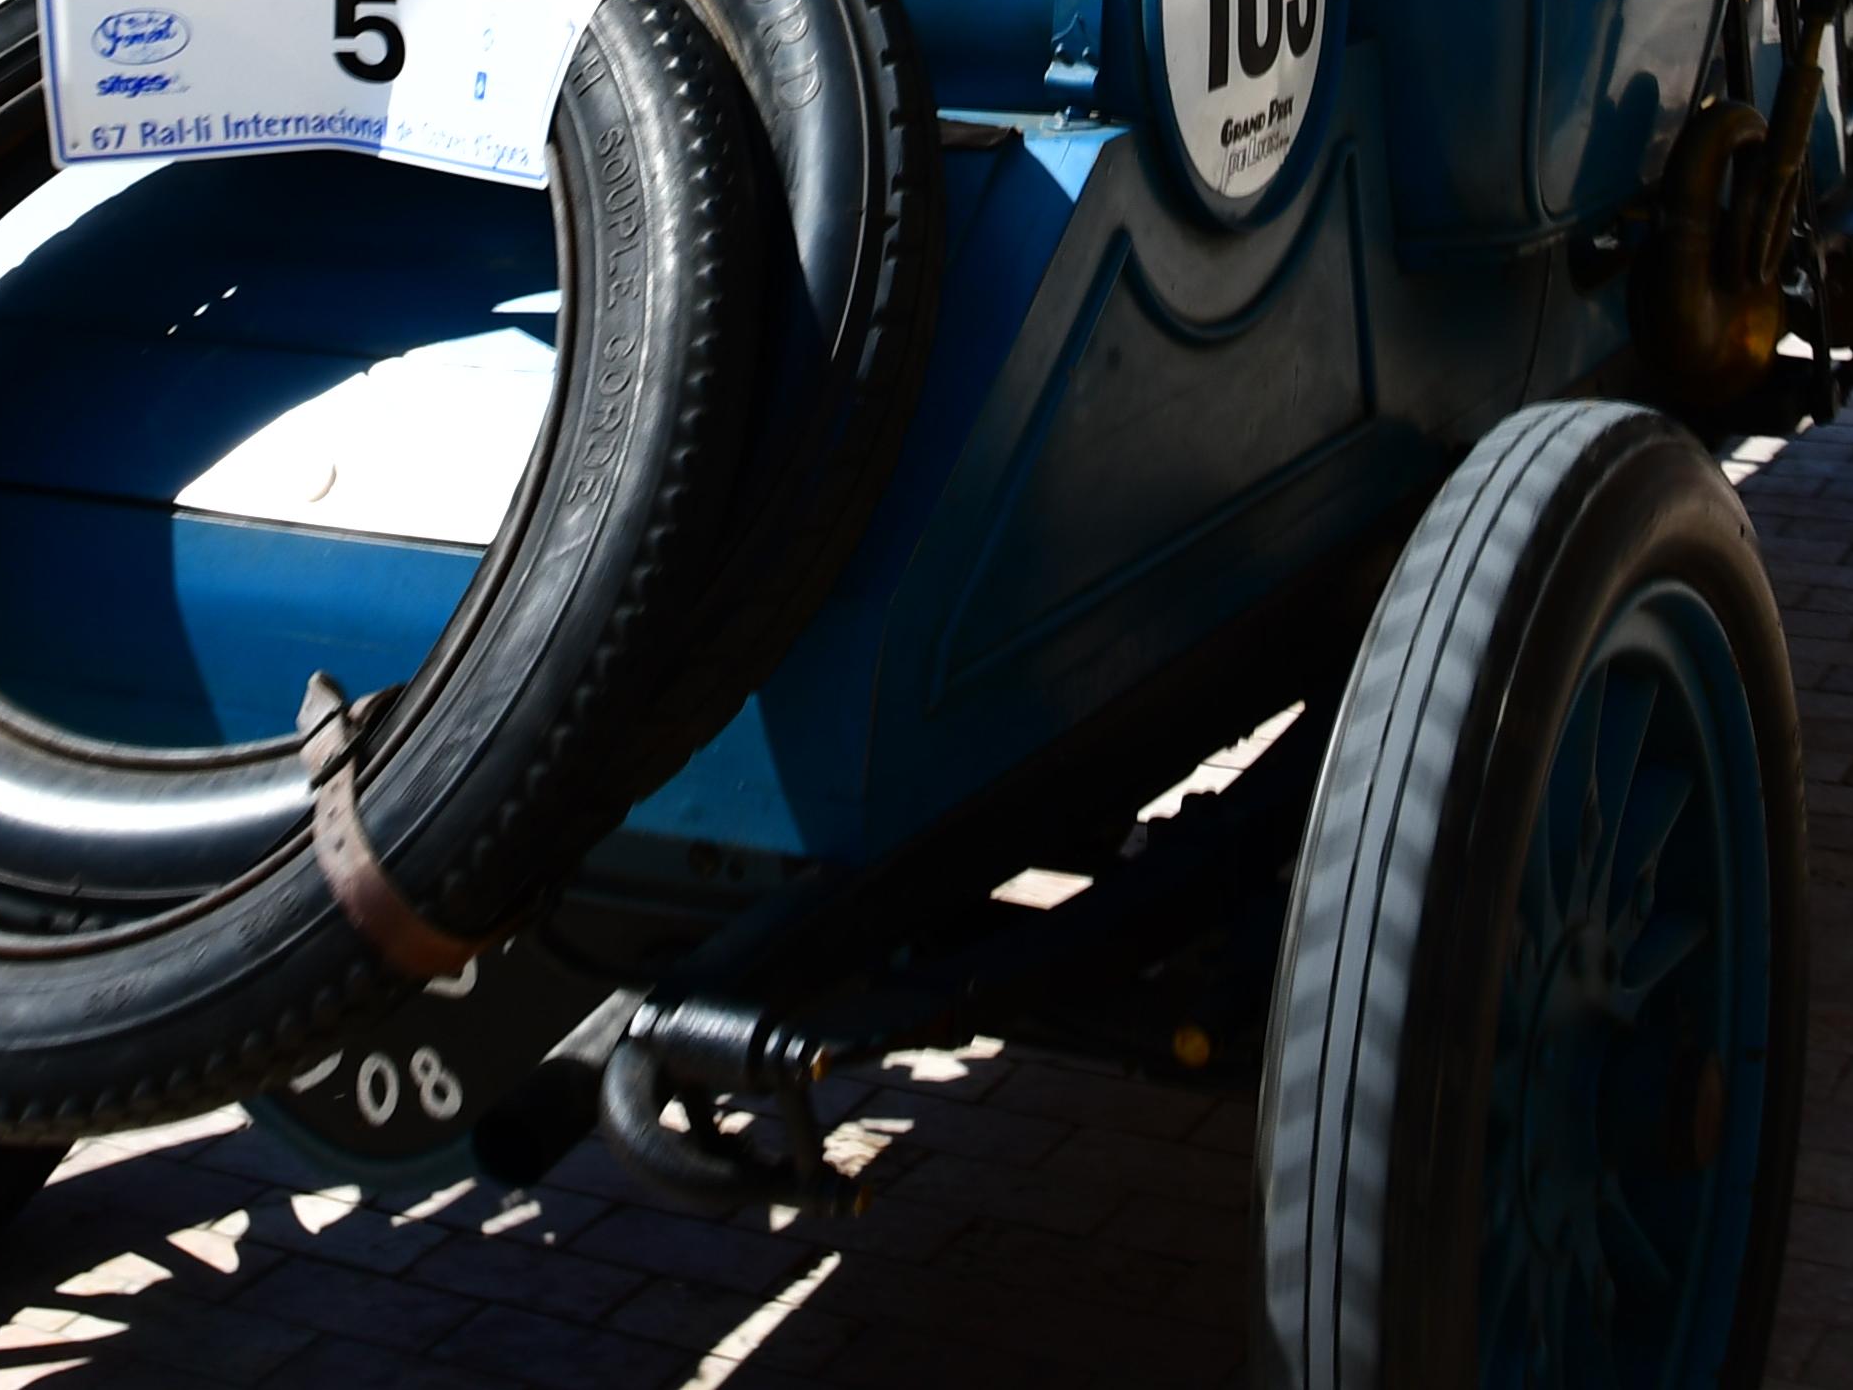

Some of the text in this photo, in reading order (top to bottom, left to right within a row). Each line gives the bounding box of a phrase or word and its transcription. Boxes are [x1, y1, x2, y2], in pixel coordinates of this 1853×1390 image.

[91, 123, 127, 151] 67
[596, 125, 642, 311] SOUPLE
[567, 333, 641, 505] CORDE
